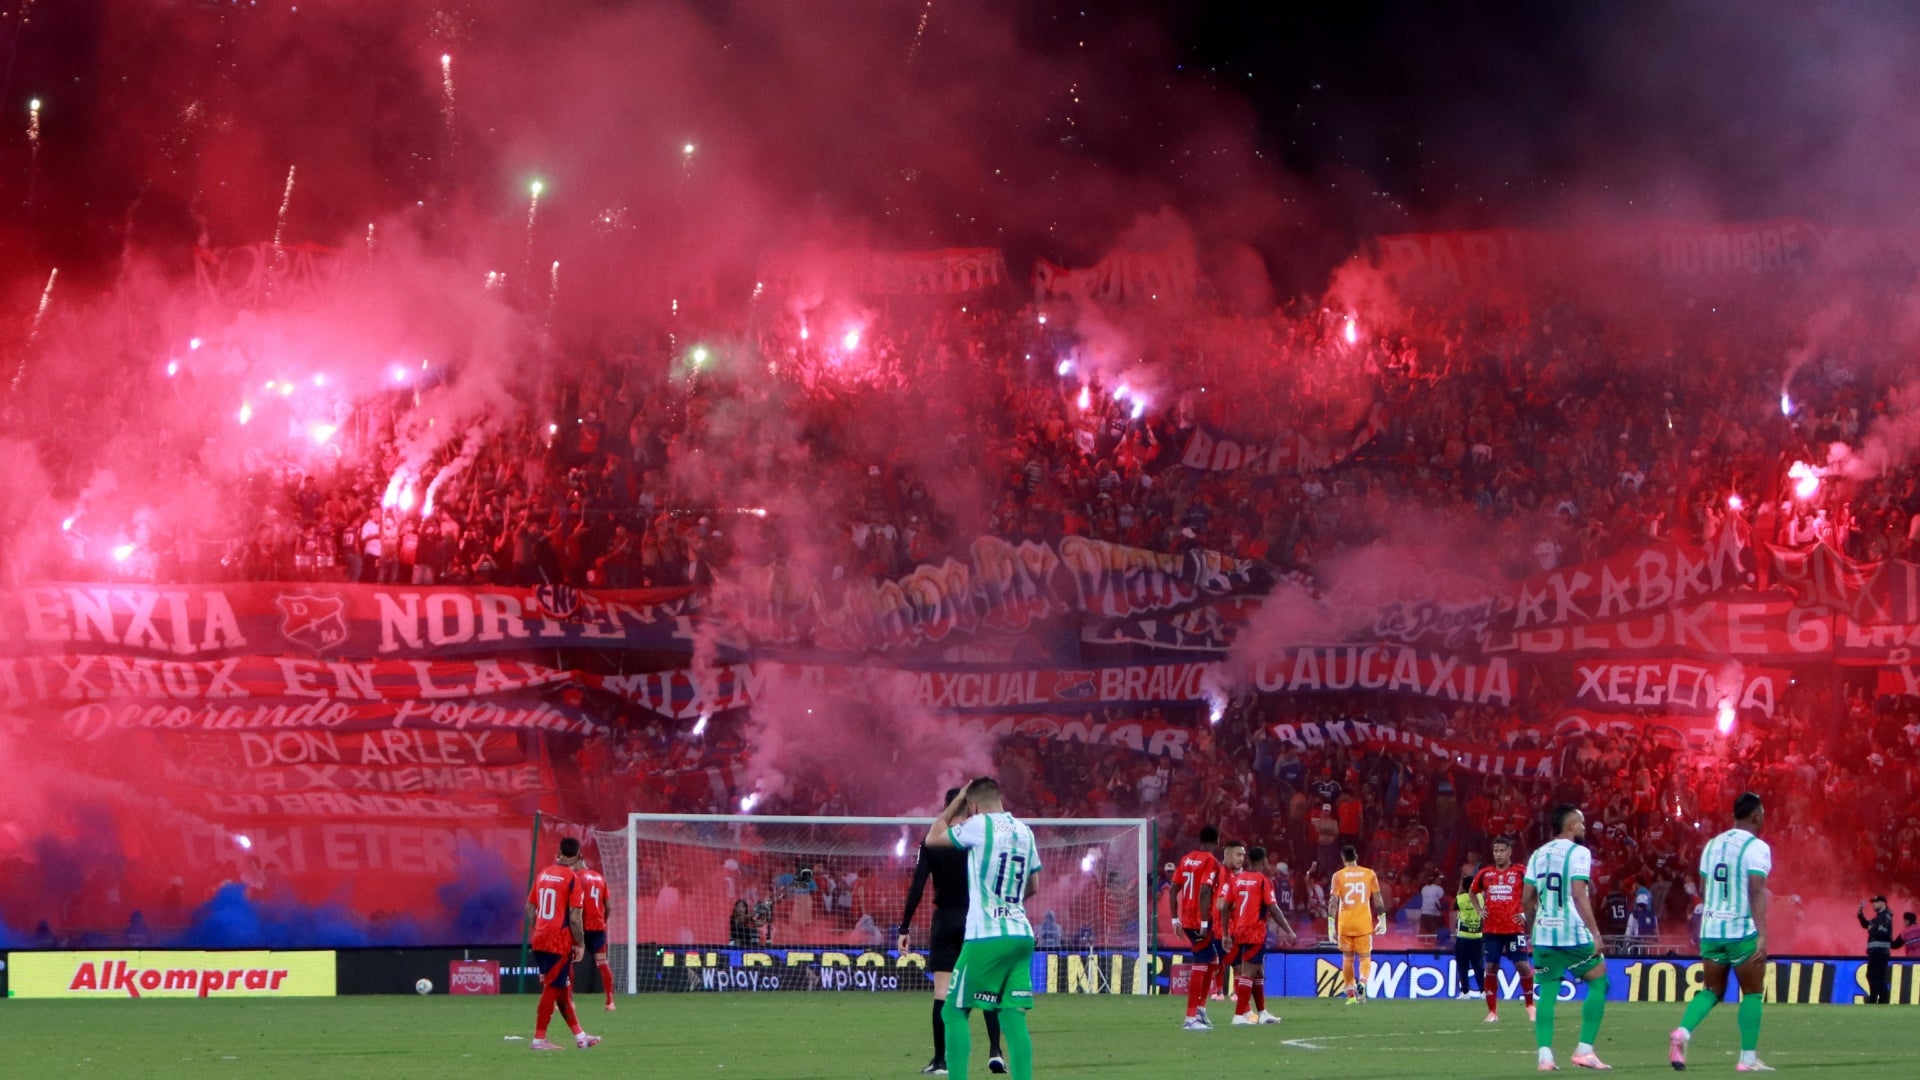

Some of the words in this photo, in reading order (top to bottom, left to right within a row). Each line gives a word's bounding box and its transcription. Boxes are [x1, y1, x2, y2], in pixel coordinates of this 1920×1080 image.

[0, 587, 247, 653] ENXIA
[274, 656, 384, 701] EN
[1254, 646, 1512, 708] CAUCAXIA
[238, 730, 341, 768] DON
[361, 729, 491, 766] ARLEY
[995, 852, 1025, 903] 13
[1183, 872, 1195, 900] 71
[1344, 881, 1367, 905] 29
[1714, 862, 1729, 901] 9
[538, 888, 556, 920] 10
[590, 885, 600, 908] 4
[1239, 891, 1249, 917] 7
[1611, 904, 1626, 919] 15
[1517, 935, 1527, 947] 15
[69, 960, 288, 998] Alkomprar
[702, 966, 780, 992] Wplay.co
[820, 966, 898, 992] Wplay.co
[1625, 961, 1705, 1002] 108
